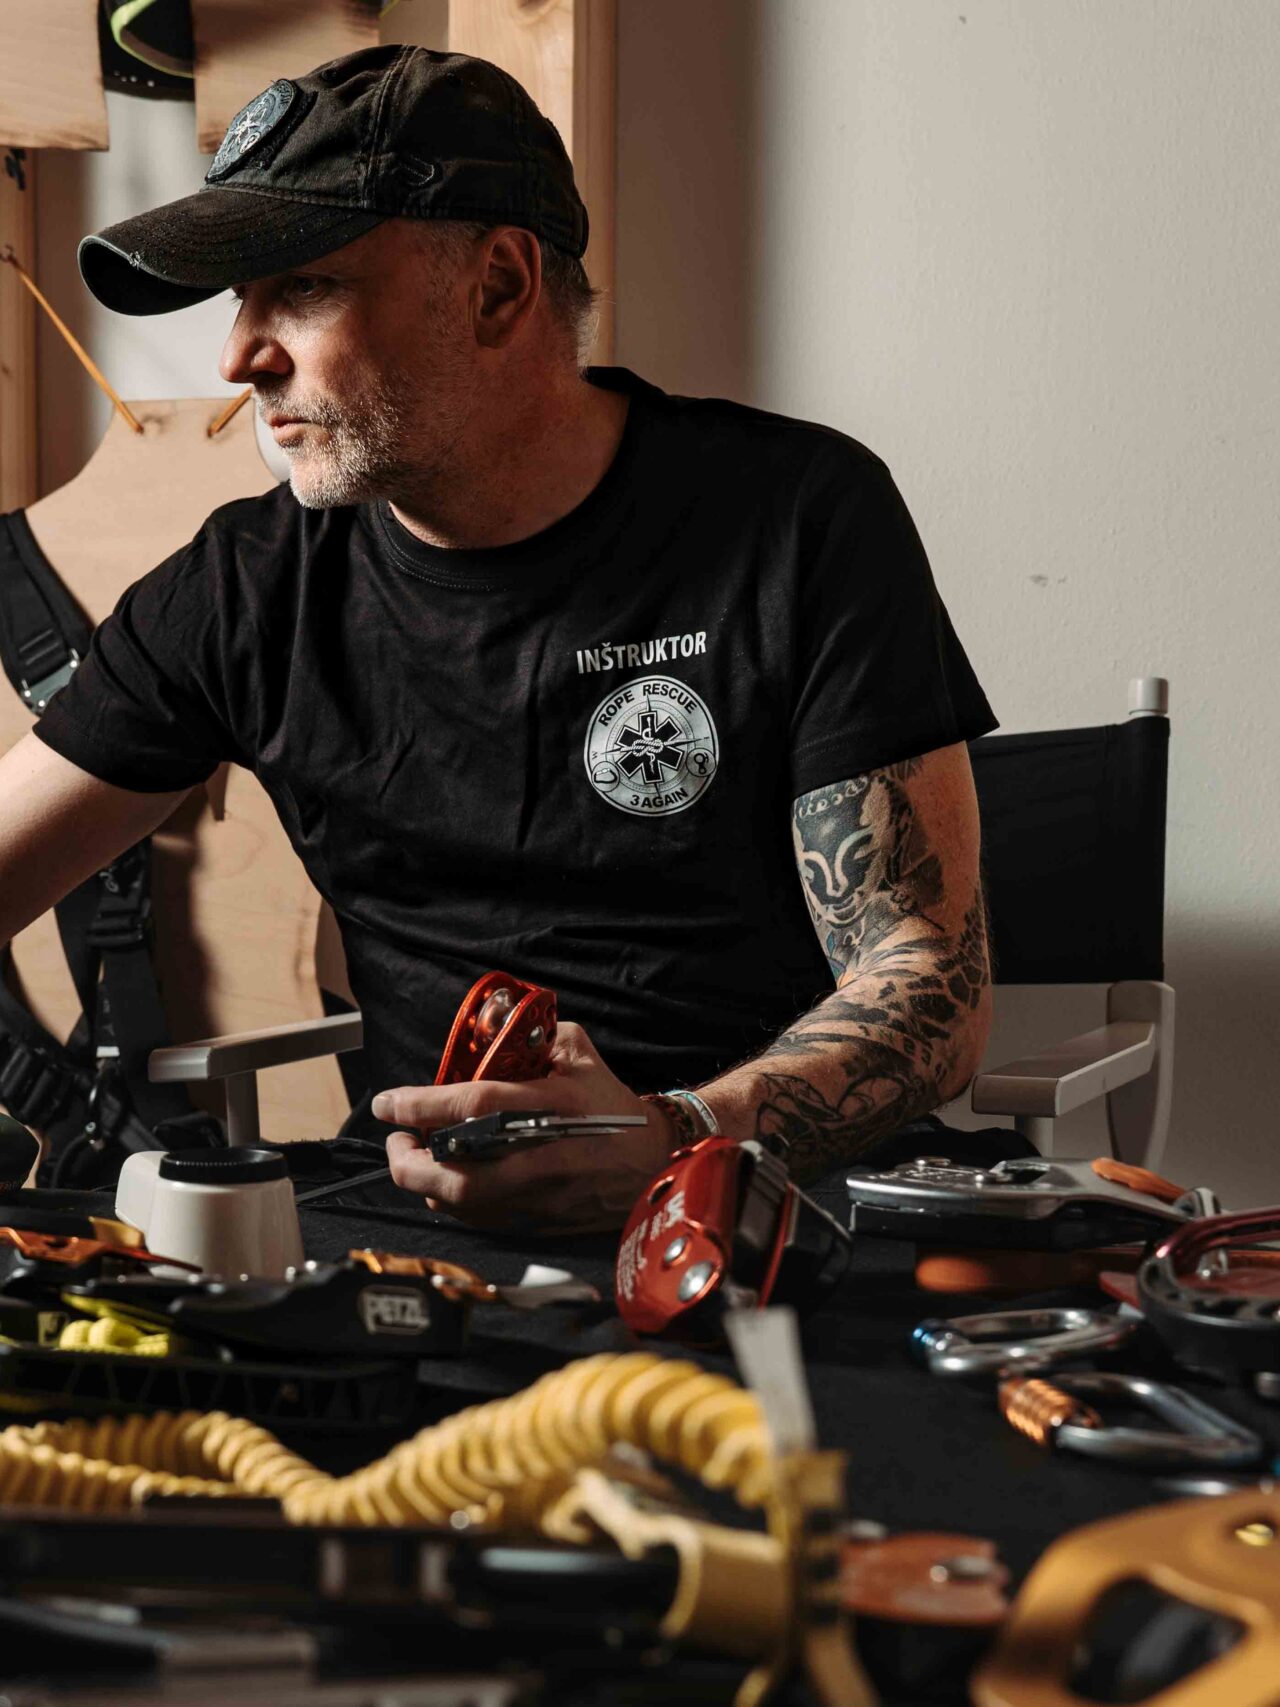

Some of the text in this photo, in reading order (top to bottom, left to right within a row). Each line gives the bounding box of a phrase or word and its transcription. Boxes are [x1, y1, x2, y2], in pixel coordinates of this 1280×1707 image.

[576, 631, 707, 674] INŠTRUKTOR
[598, 683, 698, 727] ROPE RESCUE
[362, 1290, 430, 1335] PETZL
